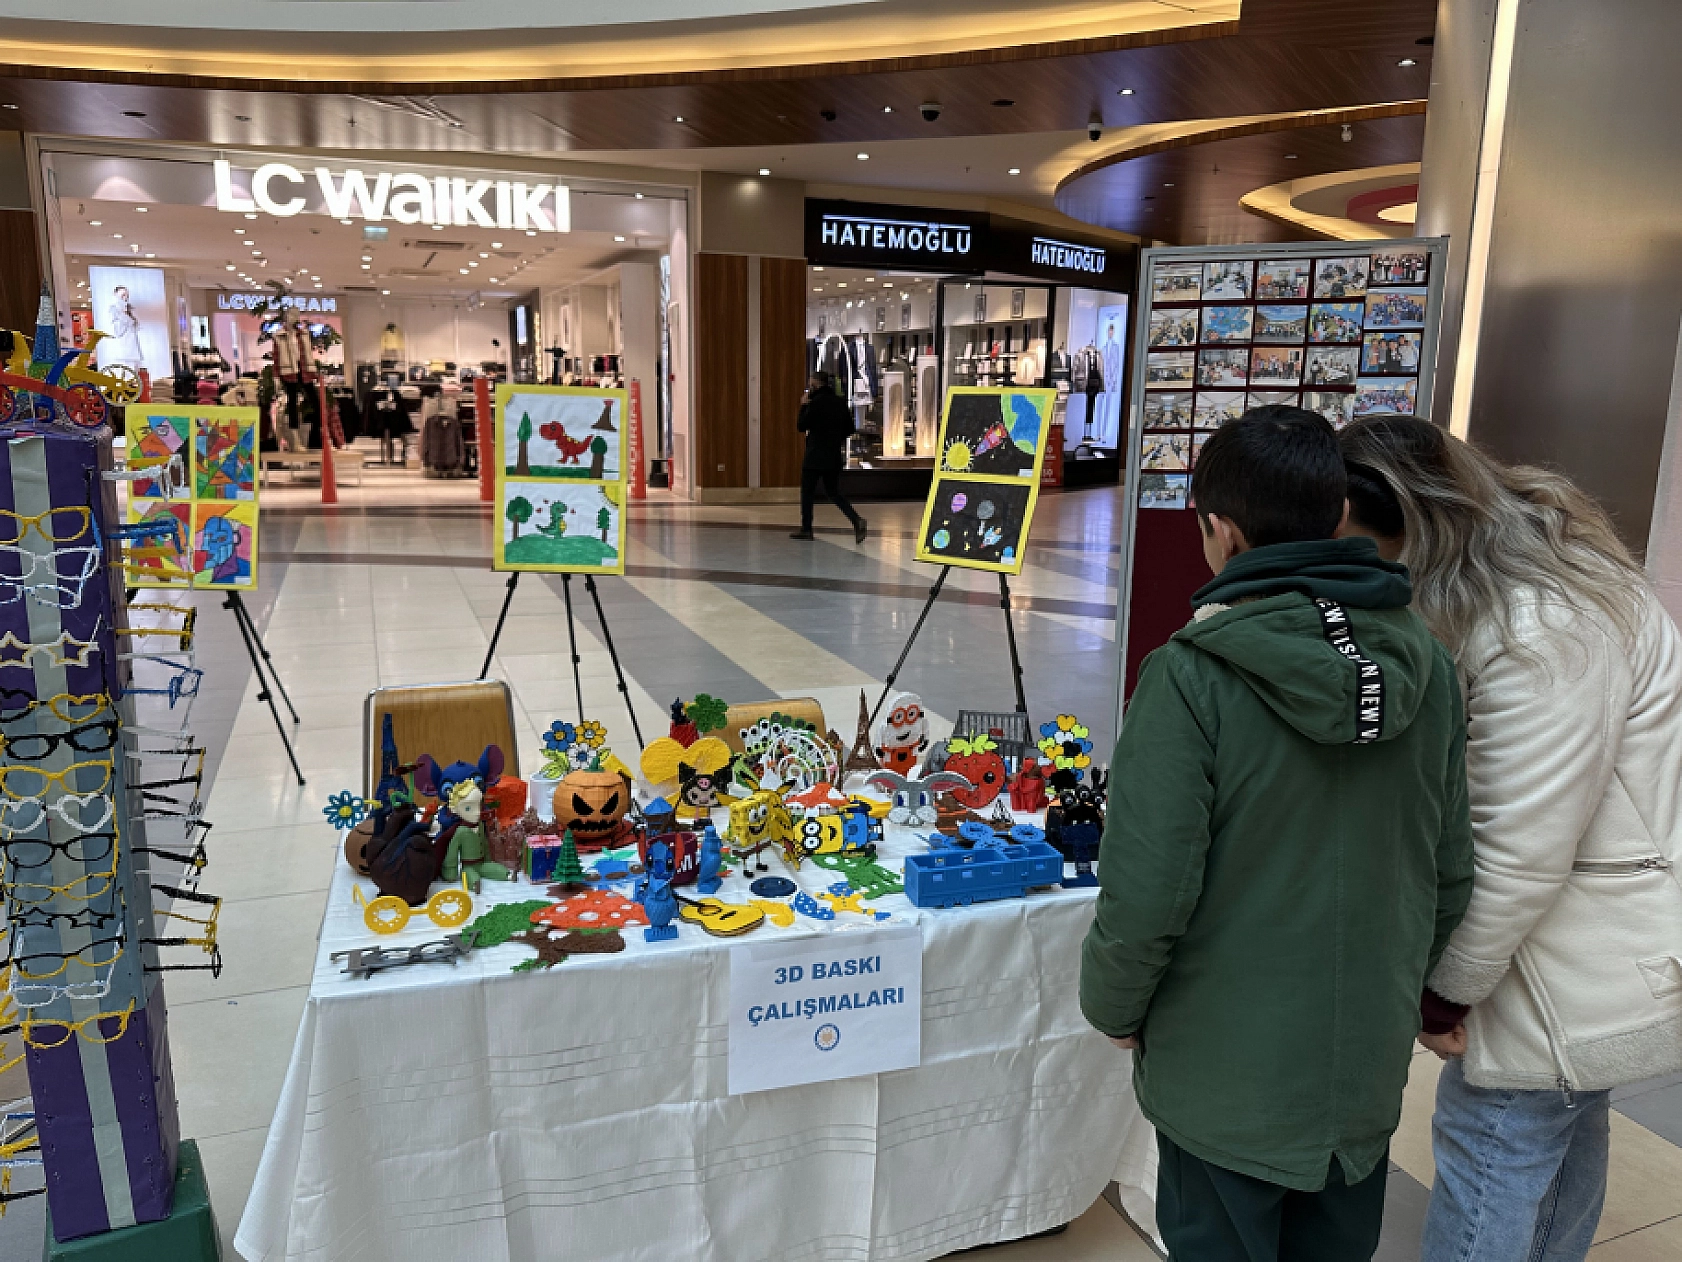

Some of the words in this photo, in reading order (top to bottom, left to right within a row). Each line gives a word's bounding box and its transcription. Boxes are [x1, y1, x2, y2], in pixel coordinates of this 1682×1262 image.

[213, 160, 306, 217] LC
[1359, 683, 1381, 722] NEW
[774, 965, 804, 985] 3D
[811, 954, 881, 980] BASKI
[747, 986, 905, 1027] ÇALIŞMALARI
